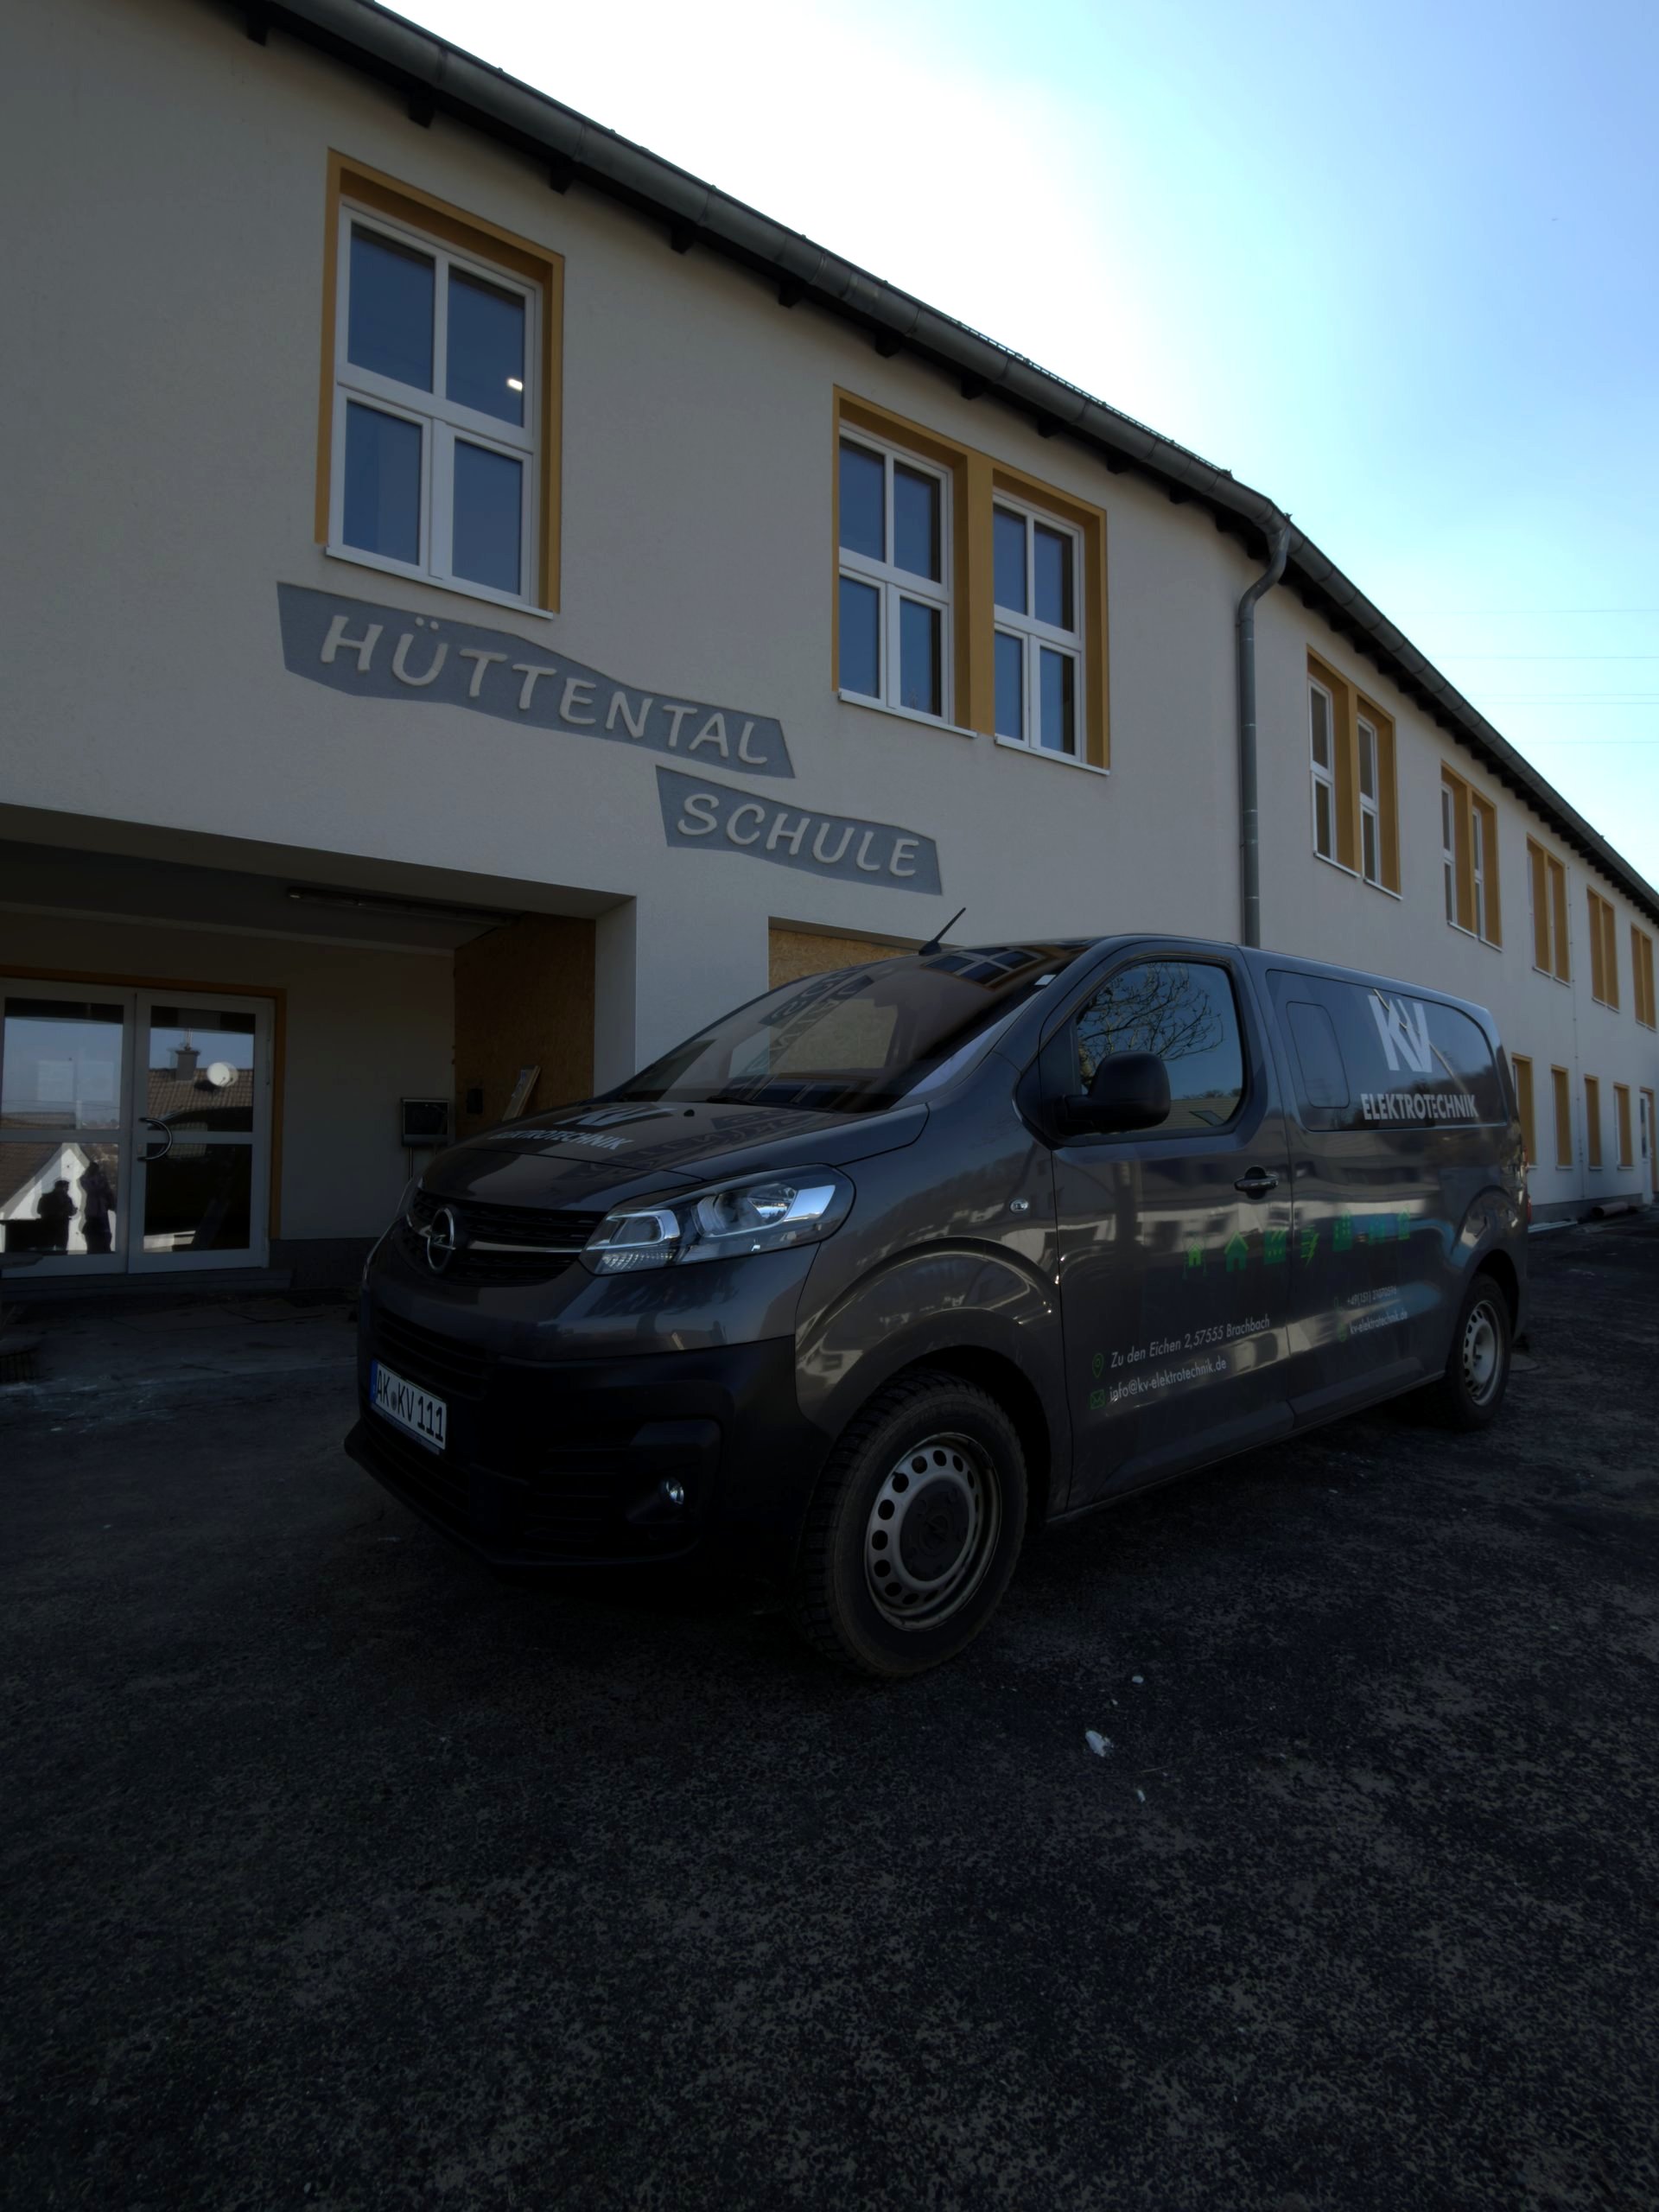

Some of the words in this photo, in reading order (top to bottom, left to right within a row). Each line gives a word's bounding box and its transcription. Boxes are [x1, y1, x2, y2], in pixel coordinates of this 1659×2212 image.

[319, 614, 768, 766] HÜTTENTAL
[677, 792, 920, 878] SCHULE
[1368, 994, 1432, 1073] KV
[1360, 1093, 1479, 1121] ELEKTROTECHNIK
[487, 1129, 634, 1149] TROTECHNIK
[1110, 1351, 1124, 1369] Zu
[1126, 1346, 1146, 1363] den
[1149, 1338, 1181, 1357] Eichen
[1226, 1313, 1270, 1338] Brachbach
[417, 1395, 443, 1442] 111
